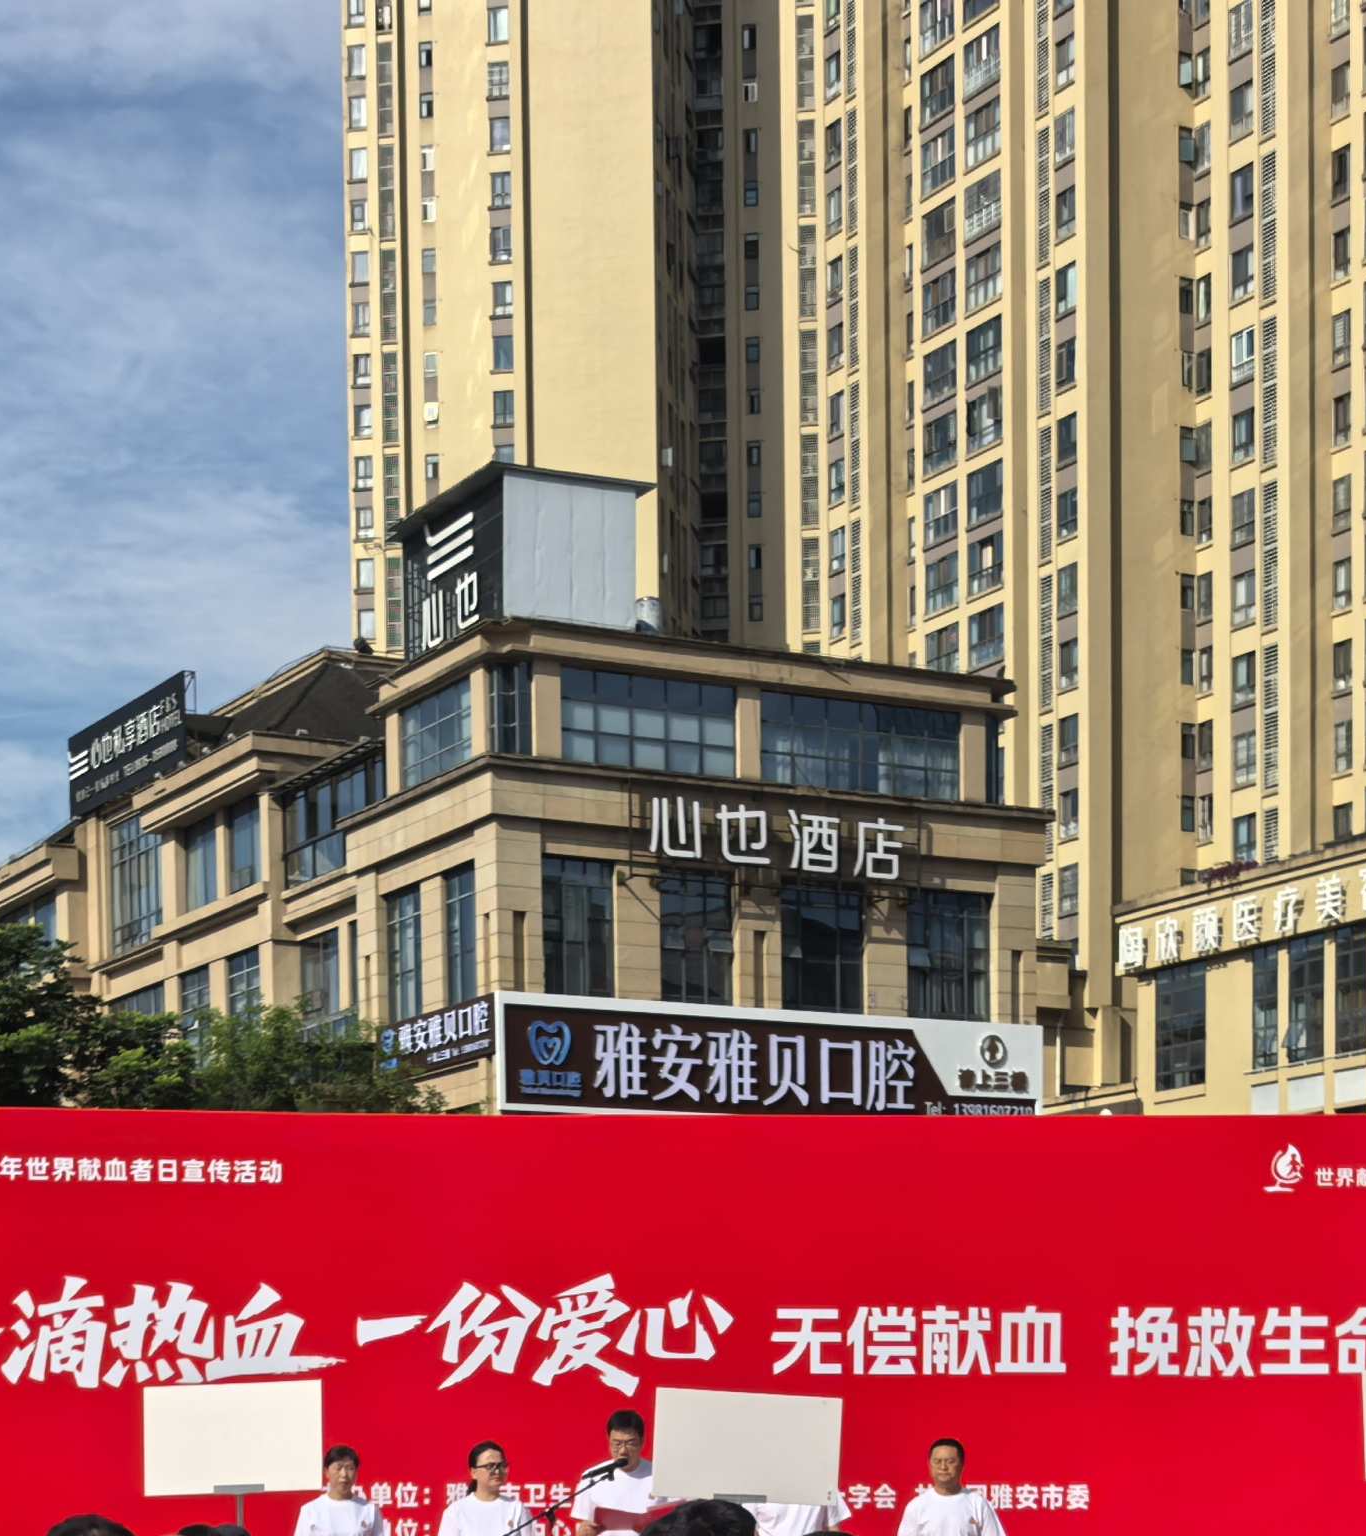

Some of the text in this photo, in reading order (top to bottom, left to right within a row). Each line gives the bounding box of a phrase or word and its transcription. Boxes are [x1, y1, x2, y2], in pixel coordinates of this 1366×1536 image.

[422, 571, 480, 651] 心也
[649, 796, 905, 880] 心也酒店
[398, 1001, 491, 1054] 雅安雅贝口腔
[593, 1021, 916, 1112] 雅安雅贝口腔
[357, 1272, 734, 1397] 一份爱心
[771, 1304, 1067, 1377] 无偿献血
